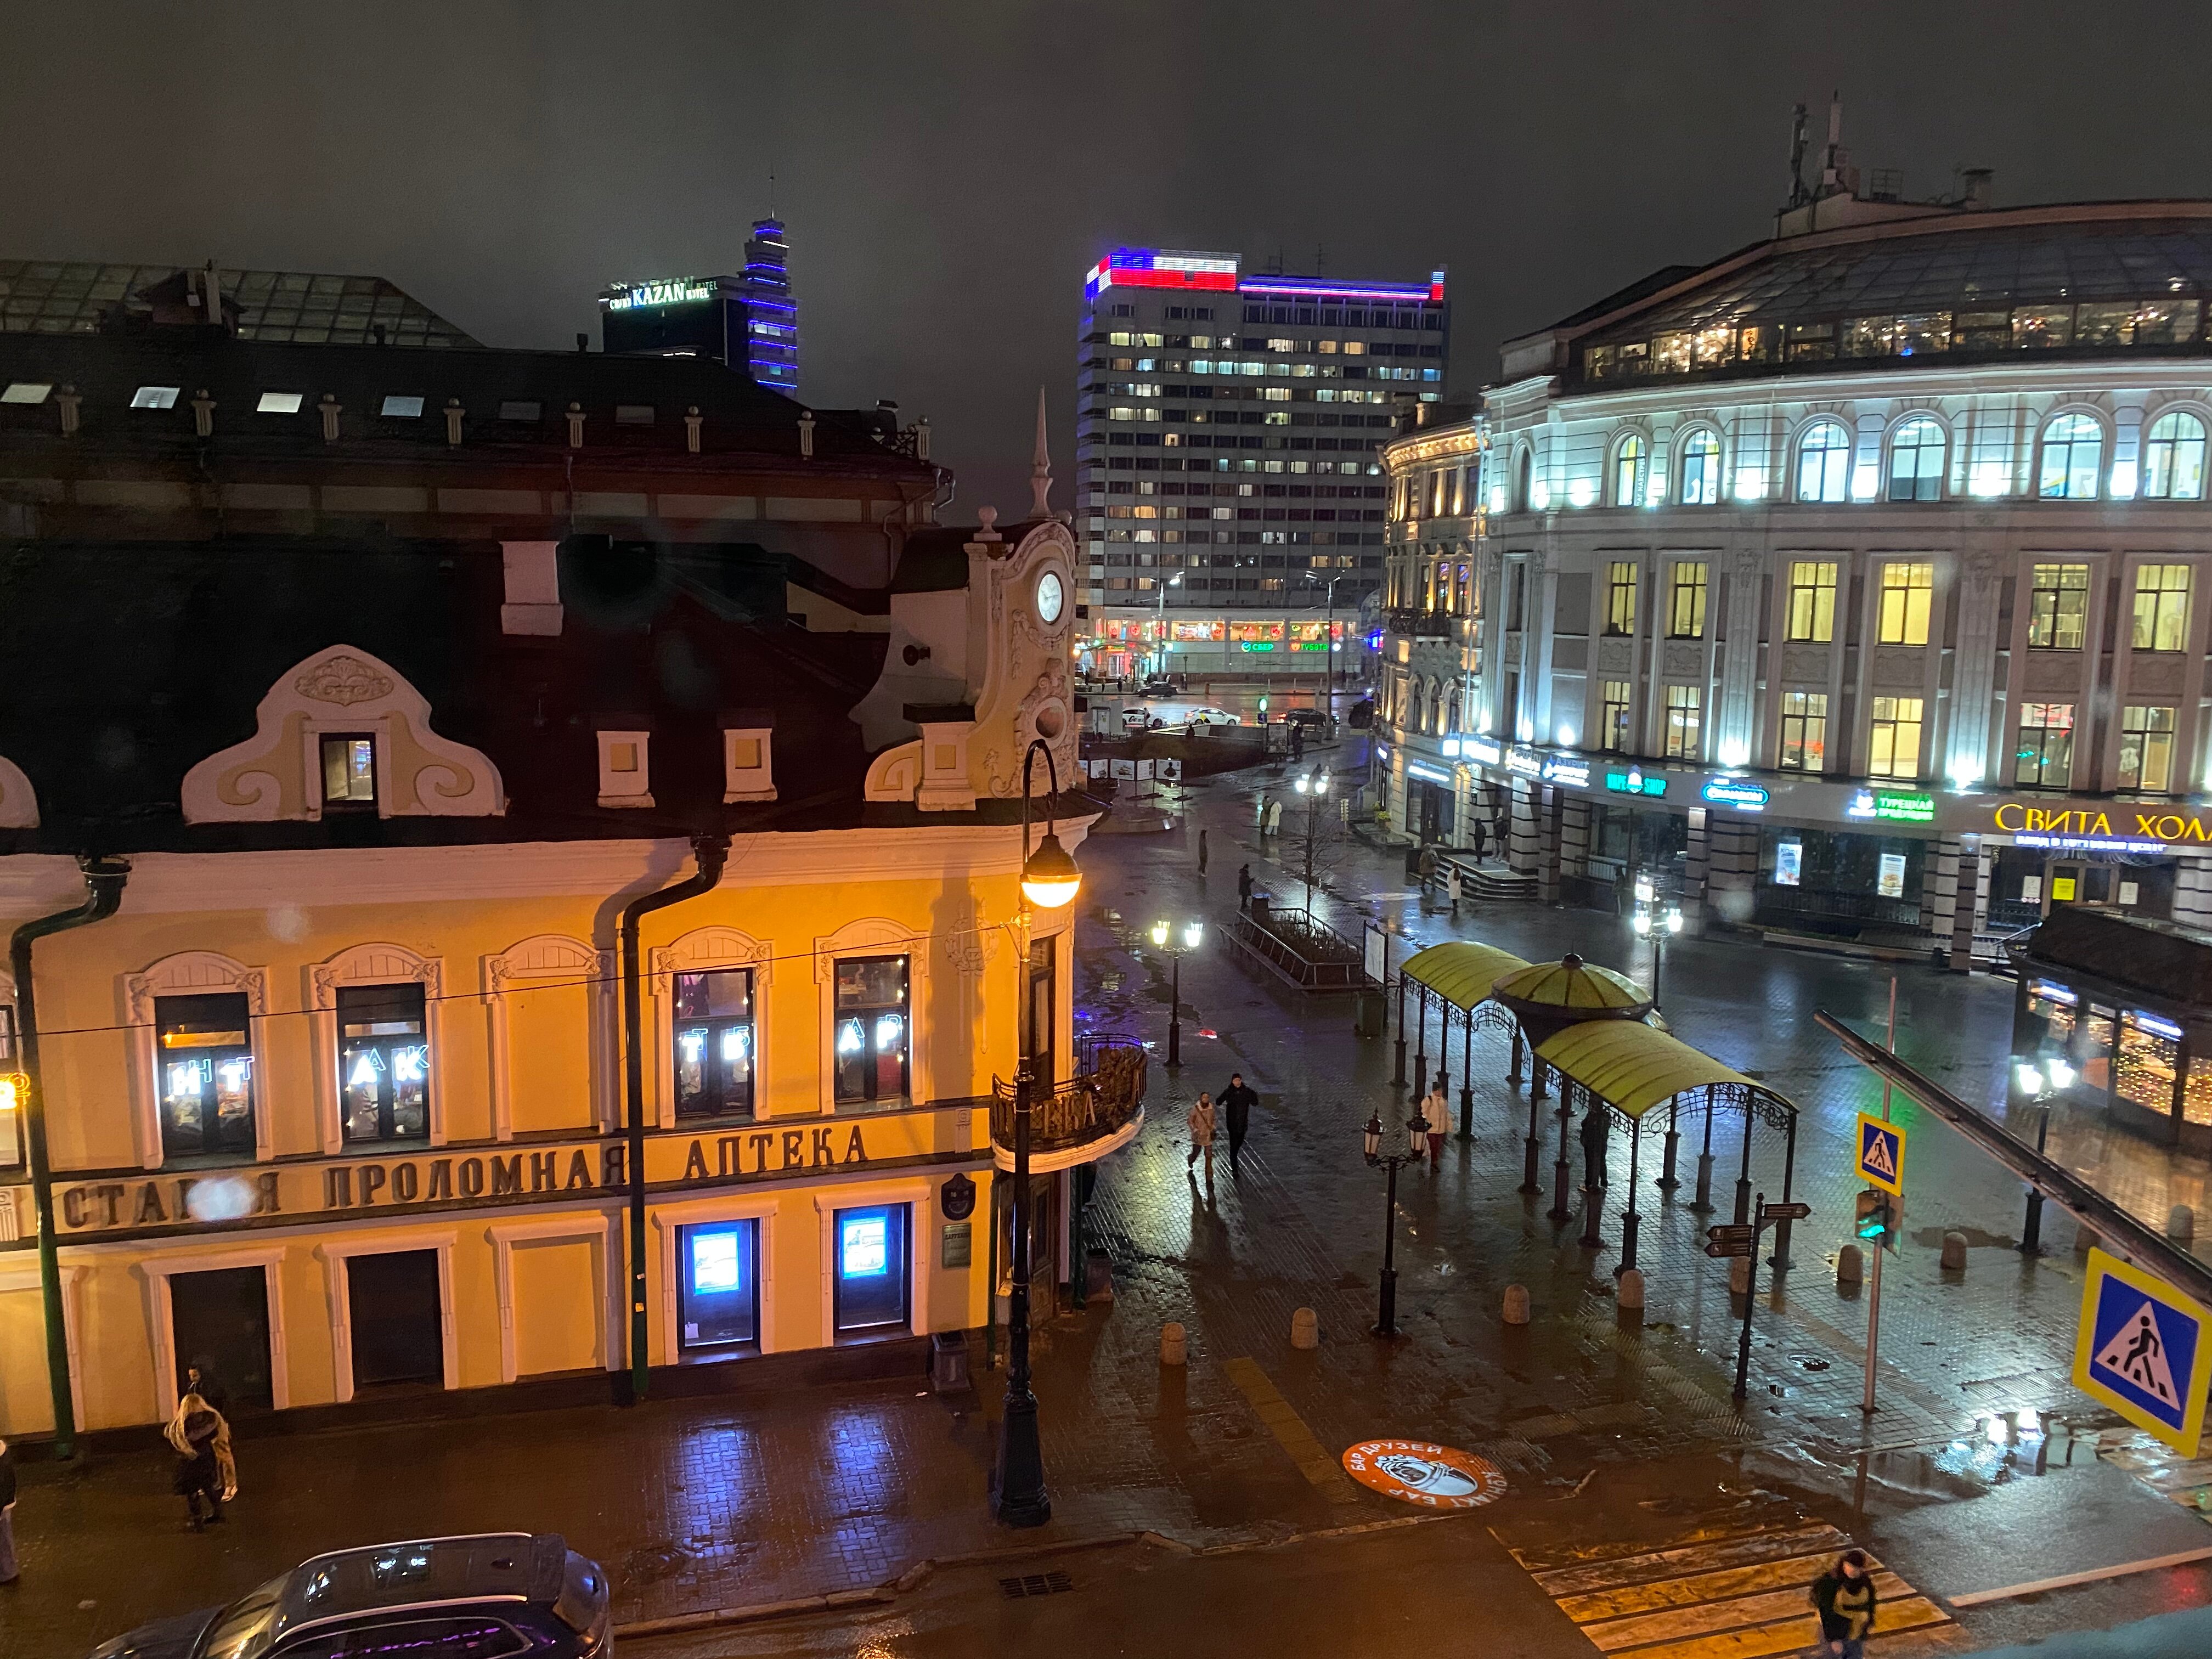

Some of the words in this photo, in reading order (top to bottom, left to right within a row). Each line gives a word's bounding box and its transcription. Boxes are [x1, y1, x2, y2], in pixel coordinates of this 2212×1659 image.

[632, 283, 685, 307] KAZAN
[686, 287, 710, 300] HOTEL
[1645, 777, 1666, 795] SHOP
[1878, 797, 1934, 811] ТУРЕЦКАЯ
[1994, 803, 2113, 837] СВИТА
[63, 1171, 281, 1228] СТАЯ
[323, 1145, 626, 1207] ПРОЛОМНАЯ
[682, 1125, 868, 1180] АПТЕКА
[1350, 1452, 1367, 1471] БАР
[1359, 1442, 1443, 1455] ДРУЗЕЙ
[1388, 1488, 1437, 1505] БАР
